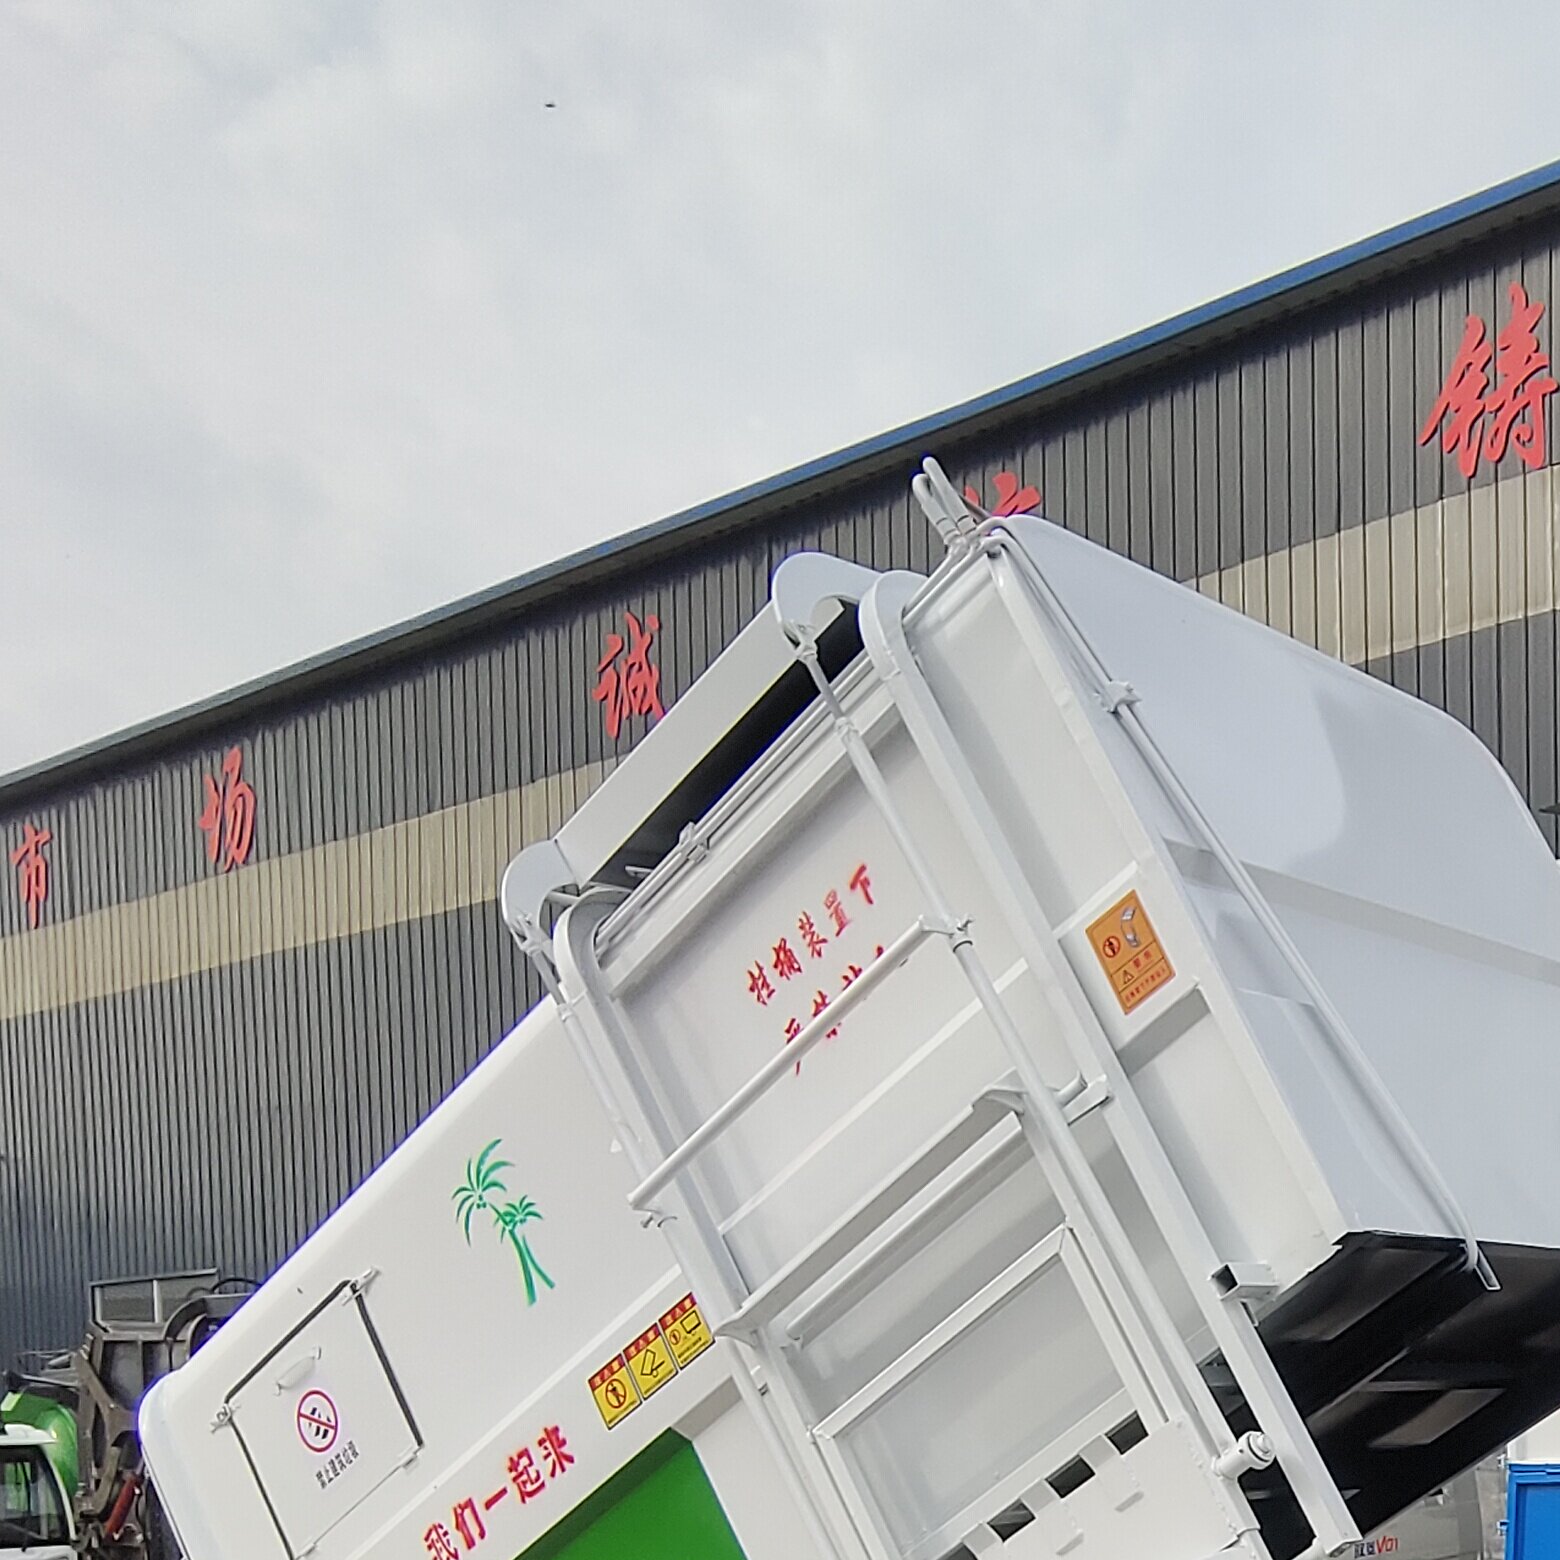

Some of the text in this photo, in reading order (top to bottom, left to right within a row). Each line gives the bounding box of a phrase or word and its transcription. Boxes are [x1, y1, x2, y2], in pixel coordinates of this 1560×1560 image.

[11, 824, 51, 925] 市
[199, 749, 255, 870] 场
[592, 613, 665, 738] 诚
[1418, 283, 1559, 478] 铸
